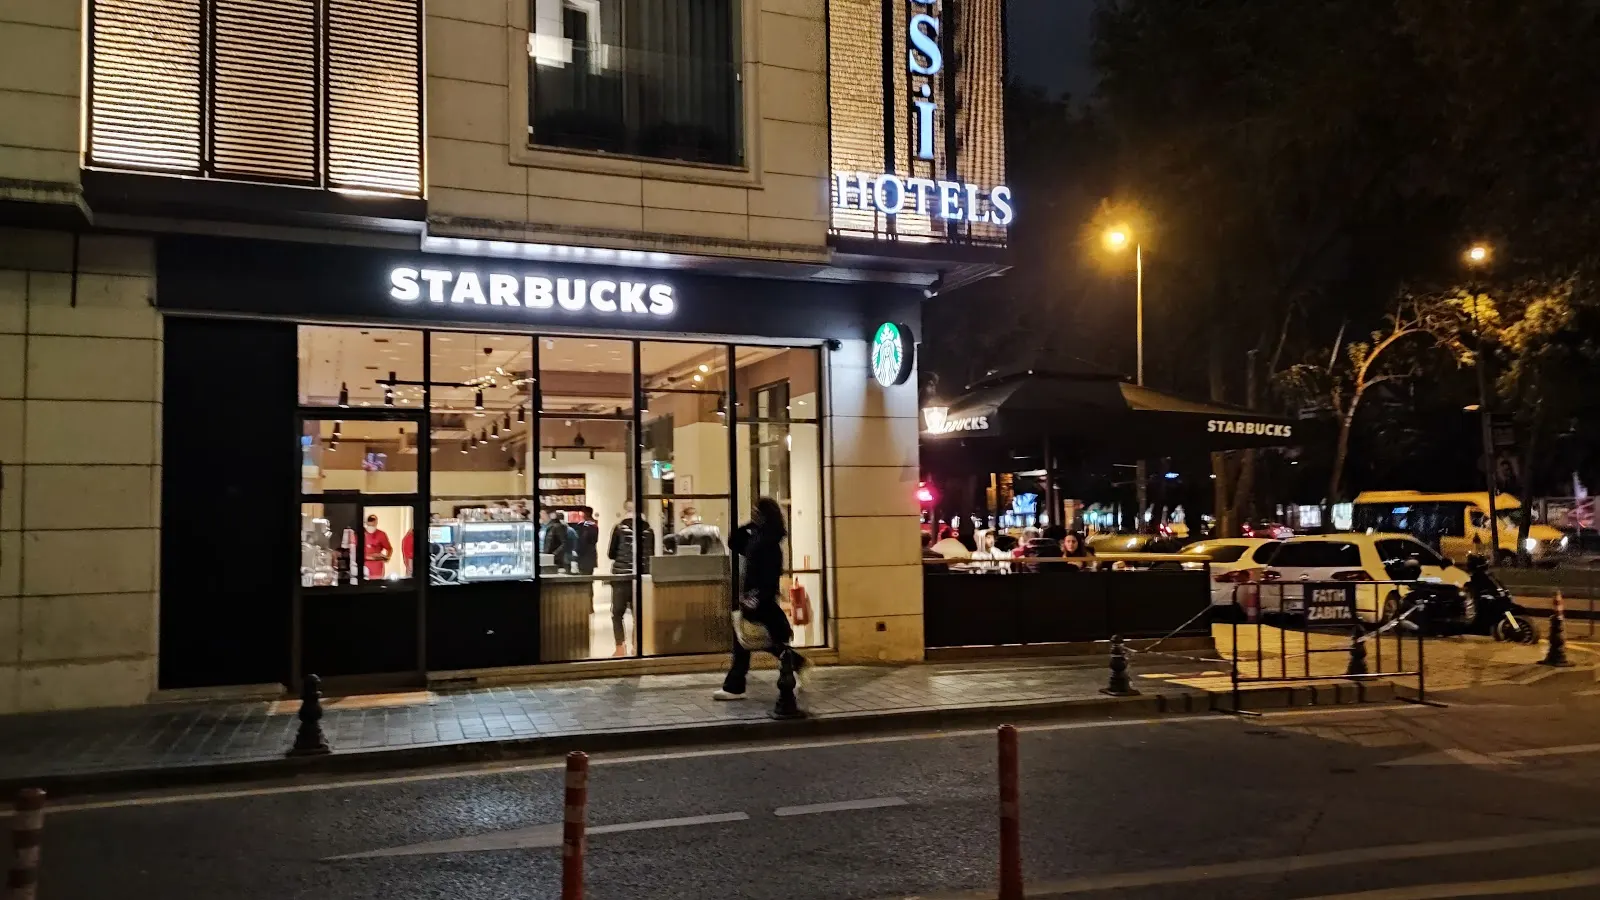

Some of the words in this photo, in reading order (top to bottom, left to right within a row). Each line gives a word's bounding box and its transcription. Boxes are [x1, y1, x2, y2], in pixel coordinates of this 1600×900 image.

[836, 171, 1013, 225] HOTELS
[390, 267, 675, 315] STARBUCKS
[1207, 420, 1292, 437] STARBUCKS
